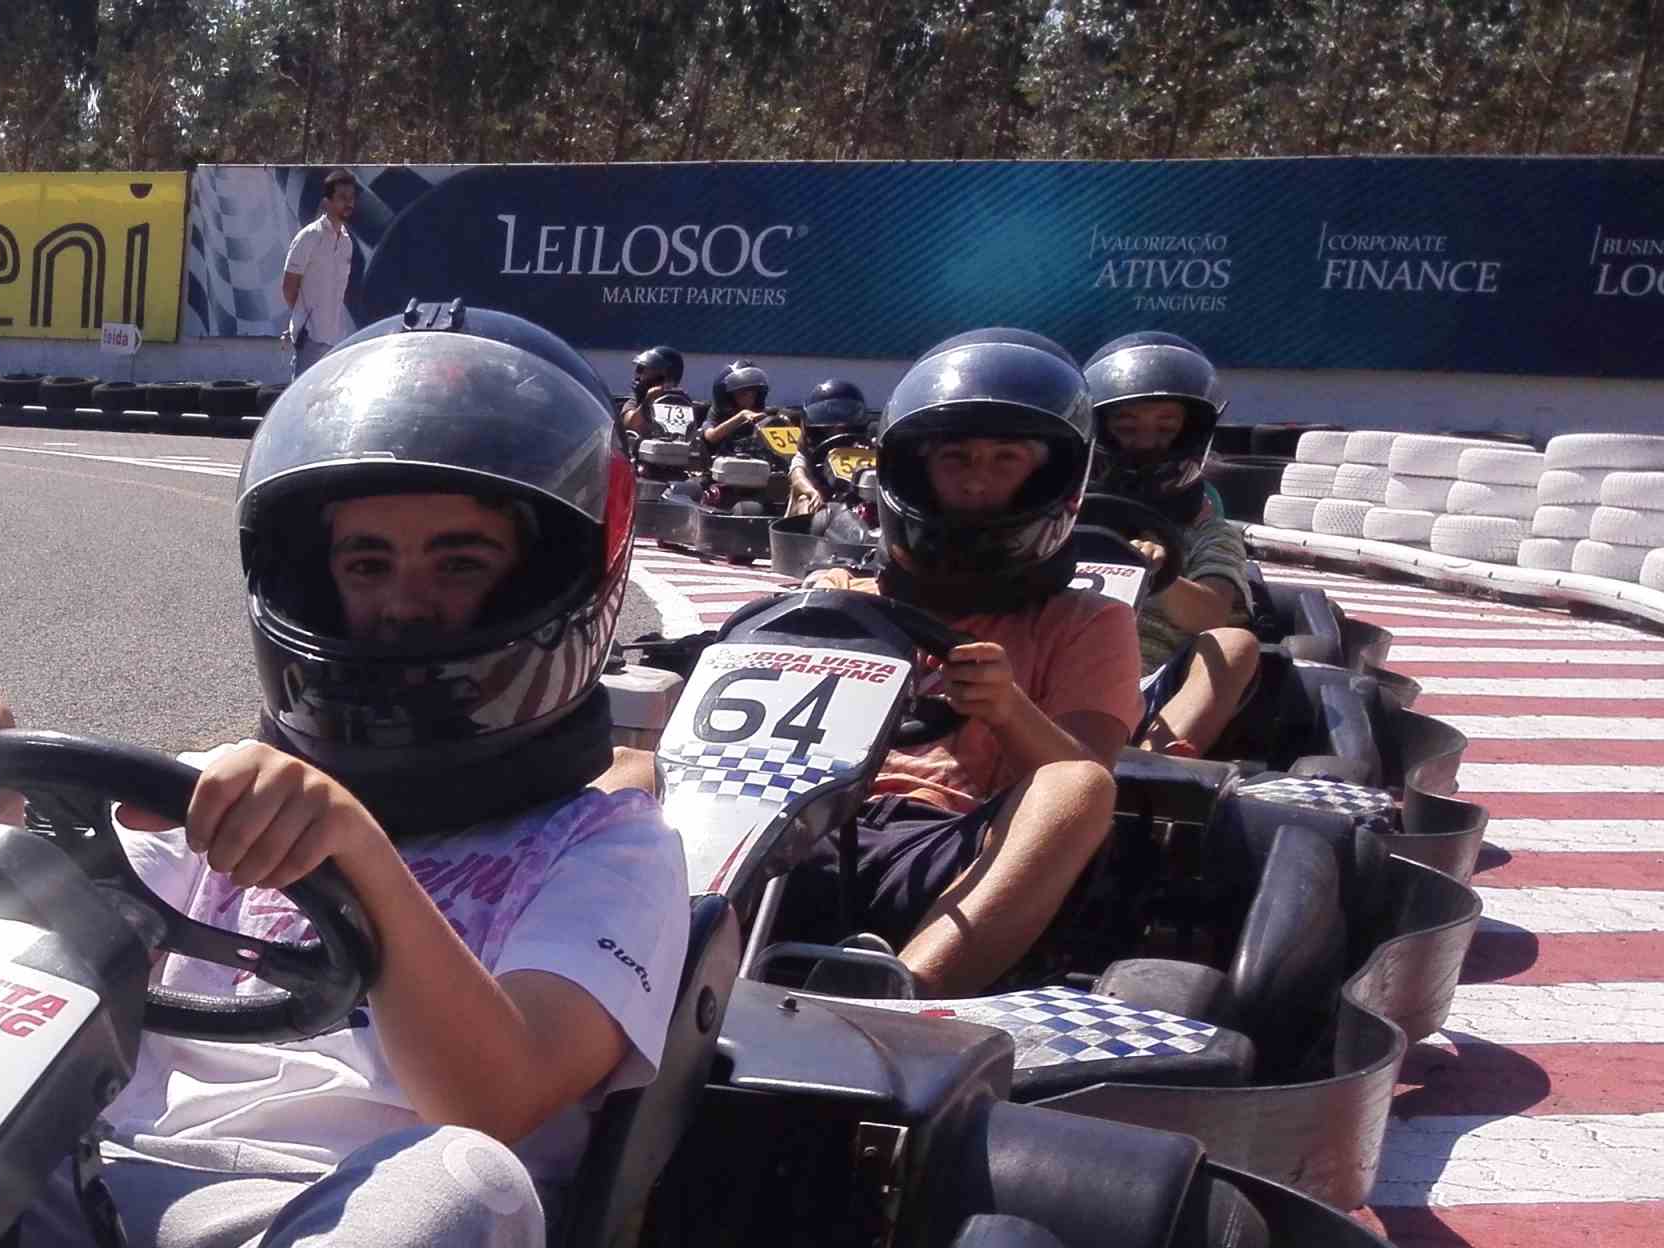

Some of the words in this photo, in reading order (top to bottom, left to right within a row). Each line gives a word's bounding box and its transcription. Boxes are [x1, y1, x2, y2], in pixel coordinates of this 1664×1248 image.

[497, 214, 793, 279] LEILOSOC
[1328, 234, 1447, 253] CORPORATE
[1094, 258, 1233, 290] ATIVOS
[1321, 259, 1501, 294] FINANCE
[601, 286, 683, 304] MARKET
[686, 287, 787, 306] PARTNERS
[664, 406, 685, 420] 73
[755, 652, 816, 666] BOA
[821, 655, 898, 675] VISTA
[693, 669, 842, 760] 64
